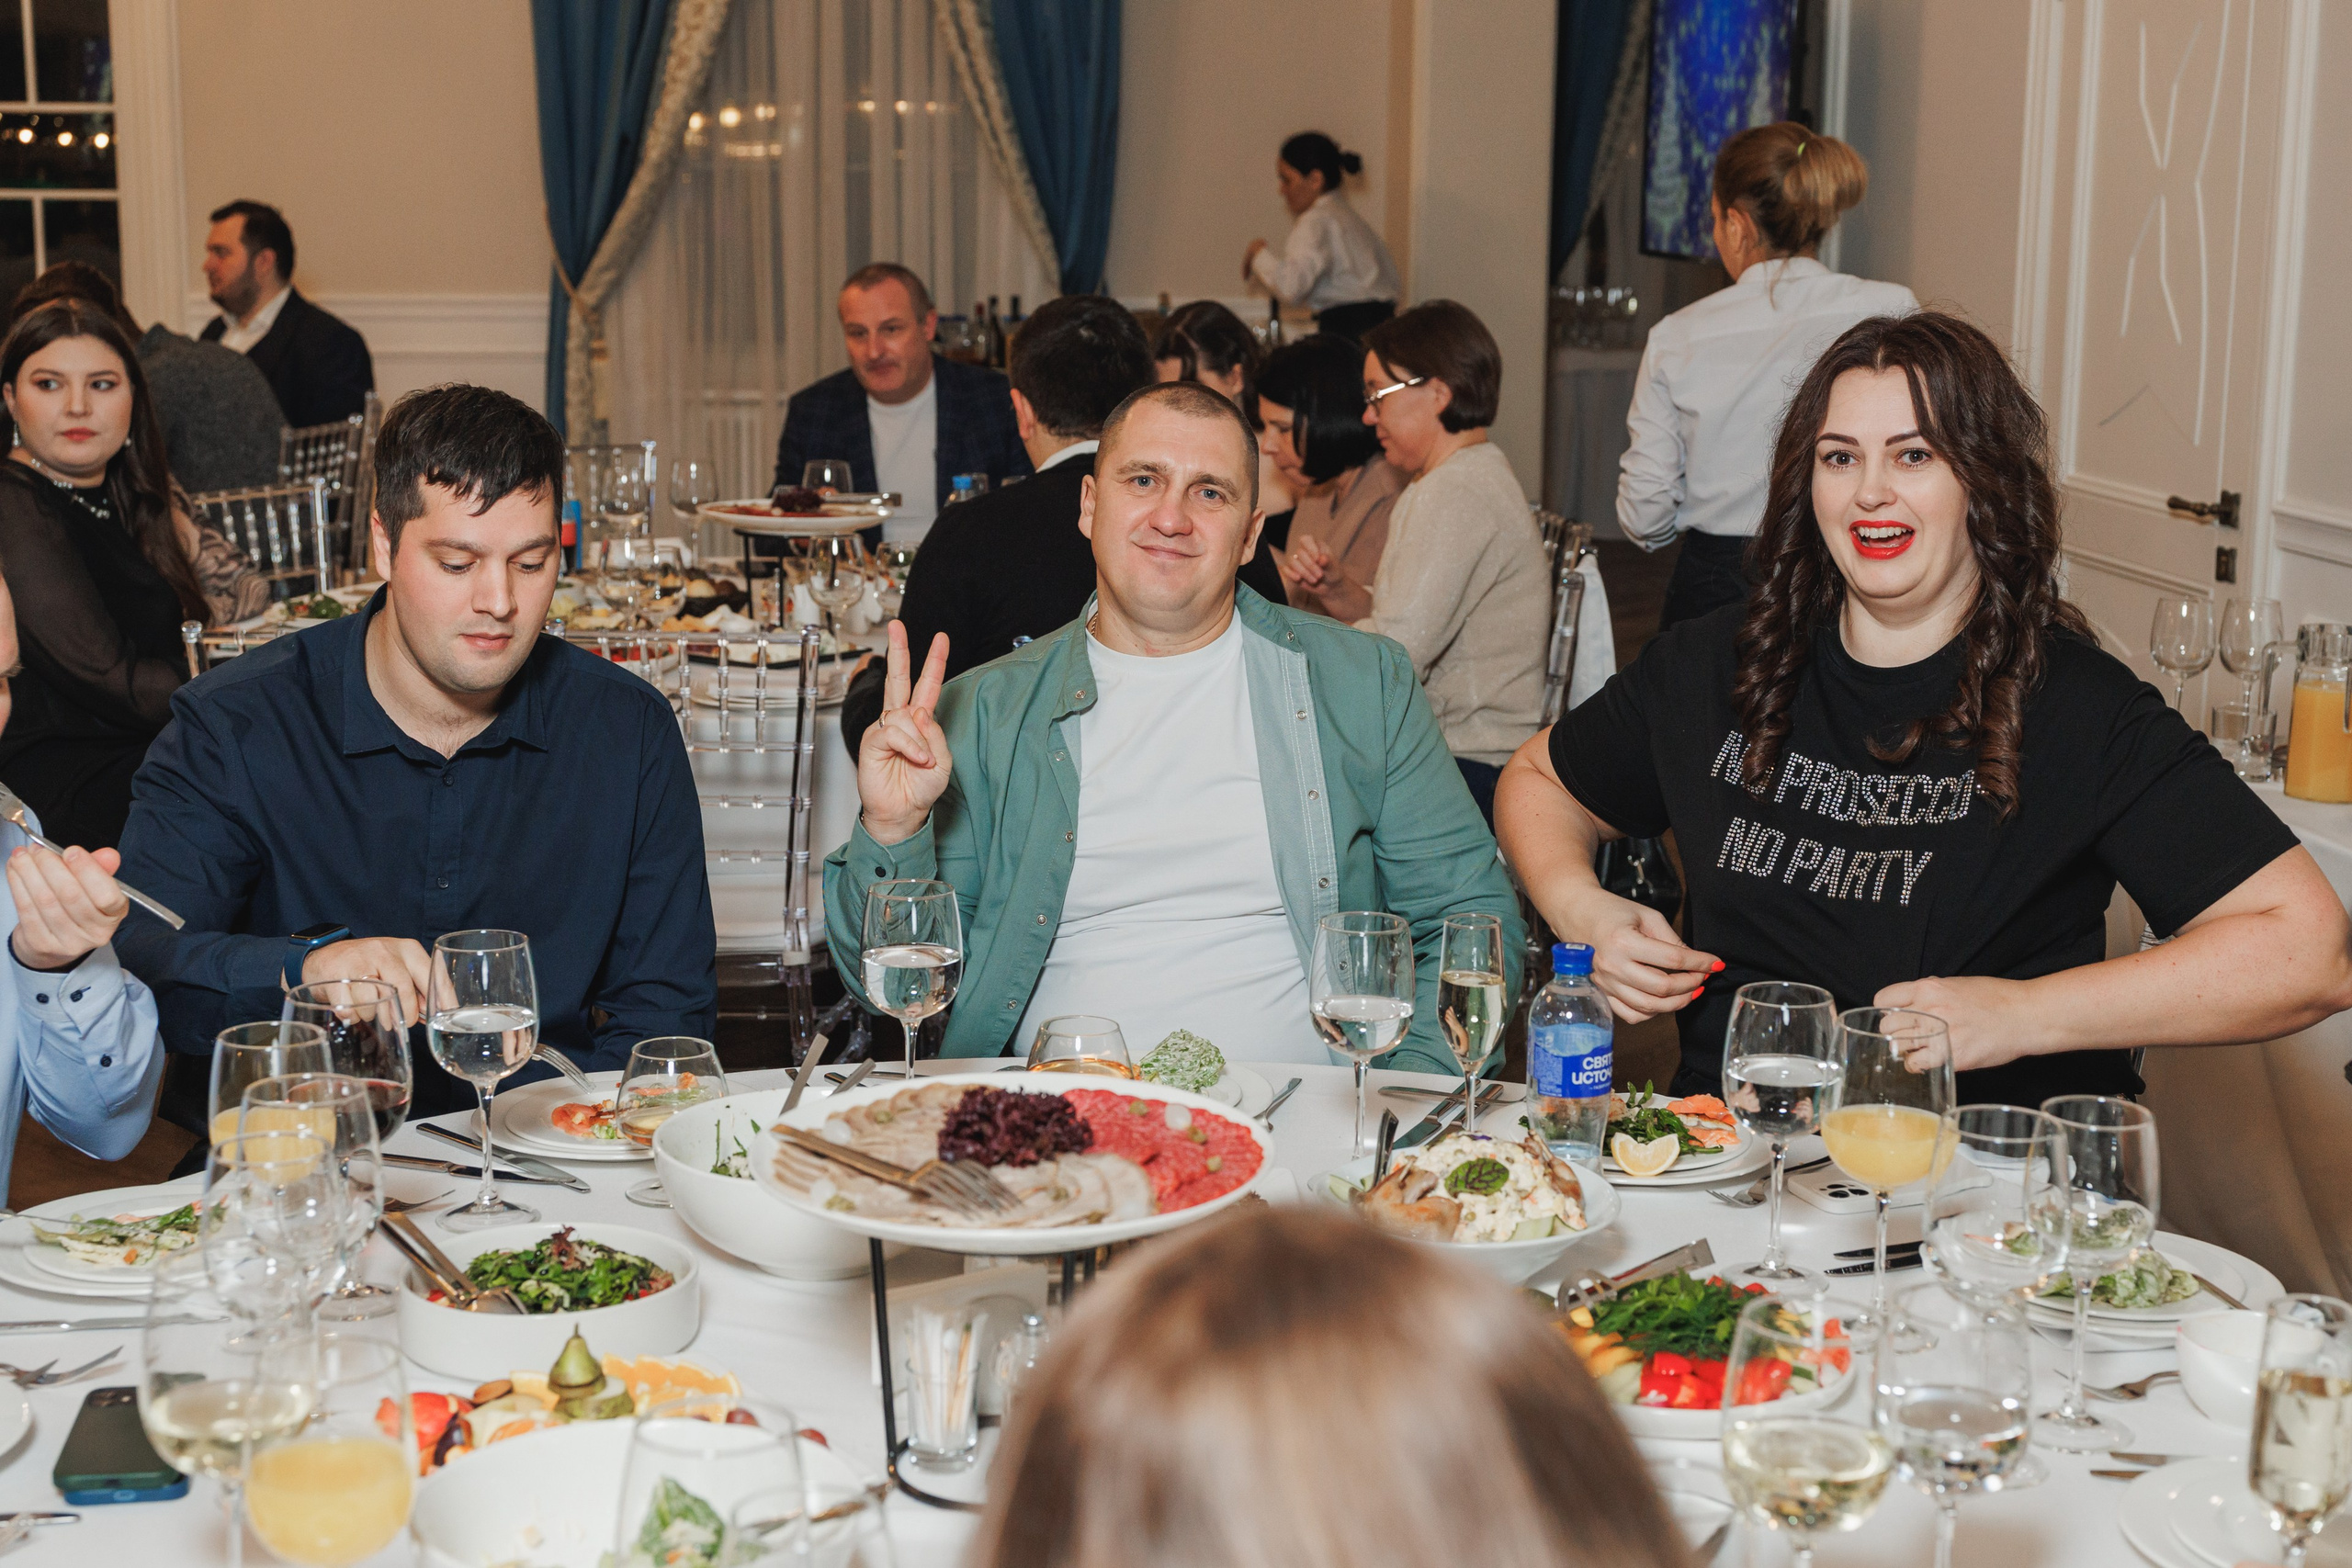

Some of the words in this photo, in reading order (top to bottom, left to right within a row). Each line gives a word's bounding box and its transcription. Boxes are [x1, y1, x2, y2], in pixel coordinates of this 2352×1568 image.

[1716, 817, 1786, 877] NO
[1782, 838, 1934, 907] PARTY
[1582, 1051, 1613, 1071] СВЯТ
